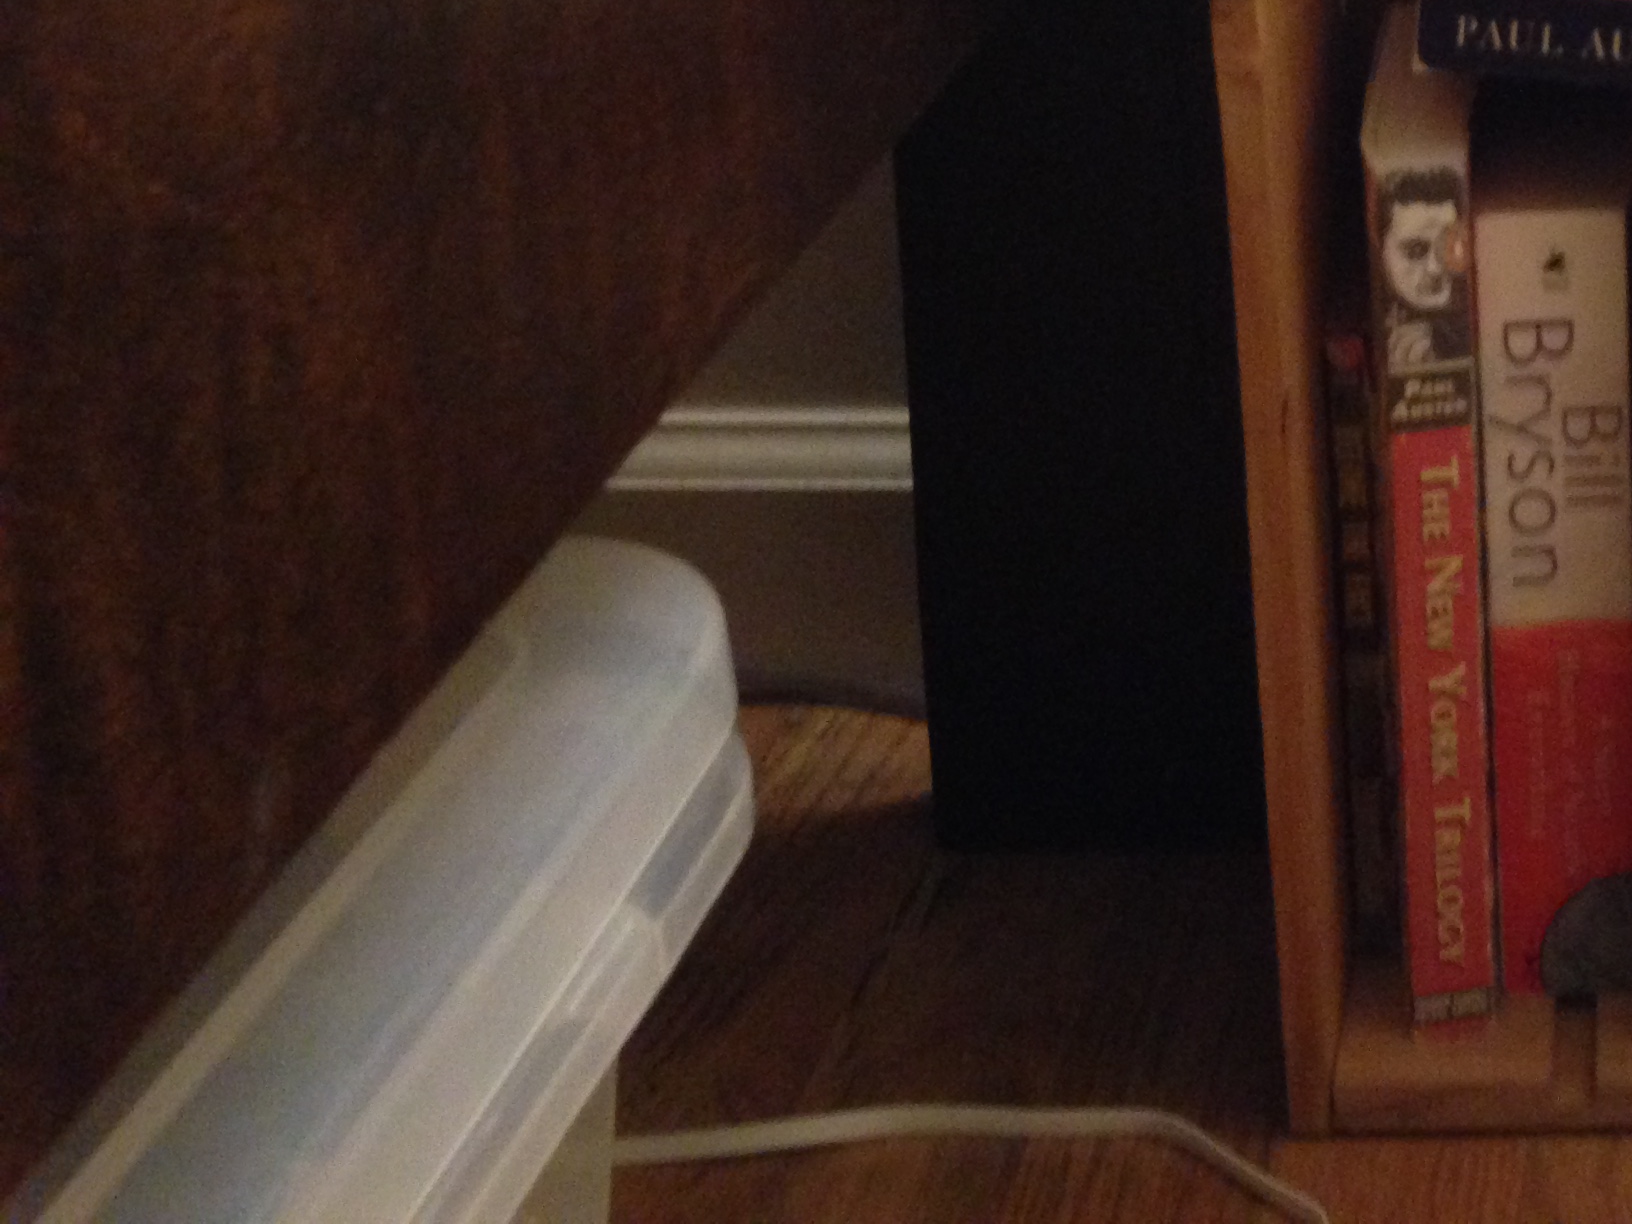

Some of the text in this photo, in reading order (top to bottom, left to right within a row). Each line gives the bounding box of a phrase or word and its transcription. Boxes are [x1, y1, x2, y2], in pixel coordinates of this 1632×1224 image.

[1454, 13, 1564, 57] PAUL
[1490, 318, 1574, 587] Bryson
[1560, 405, 1625, 508] Bill
